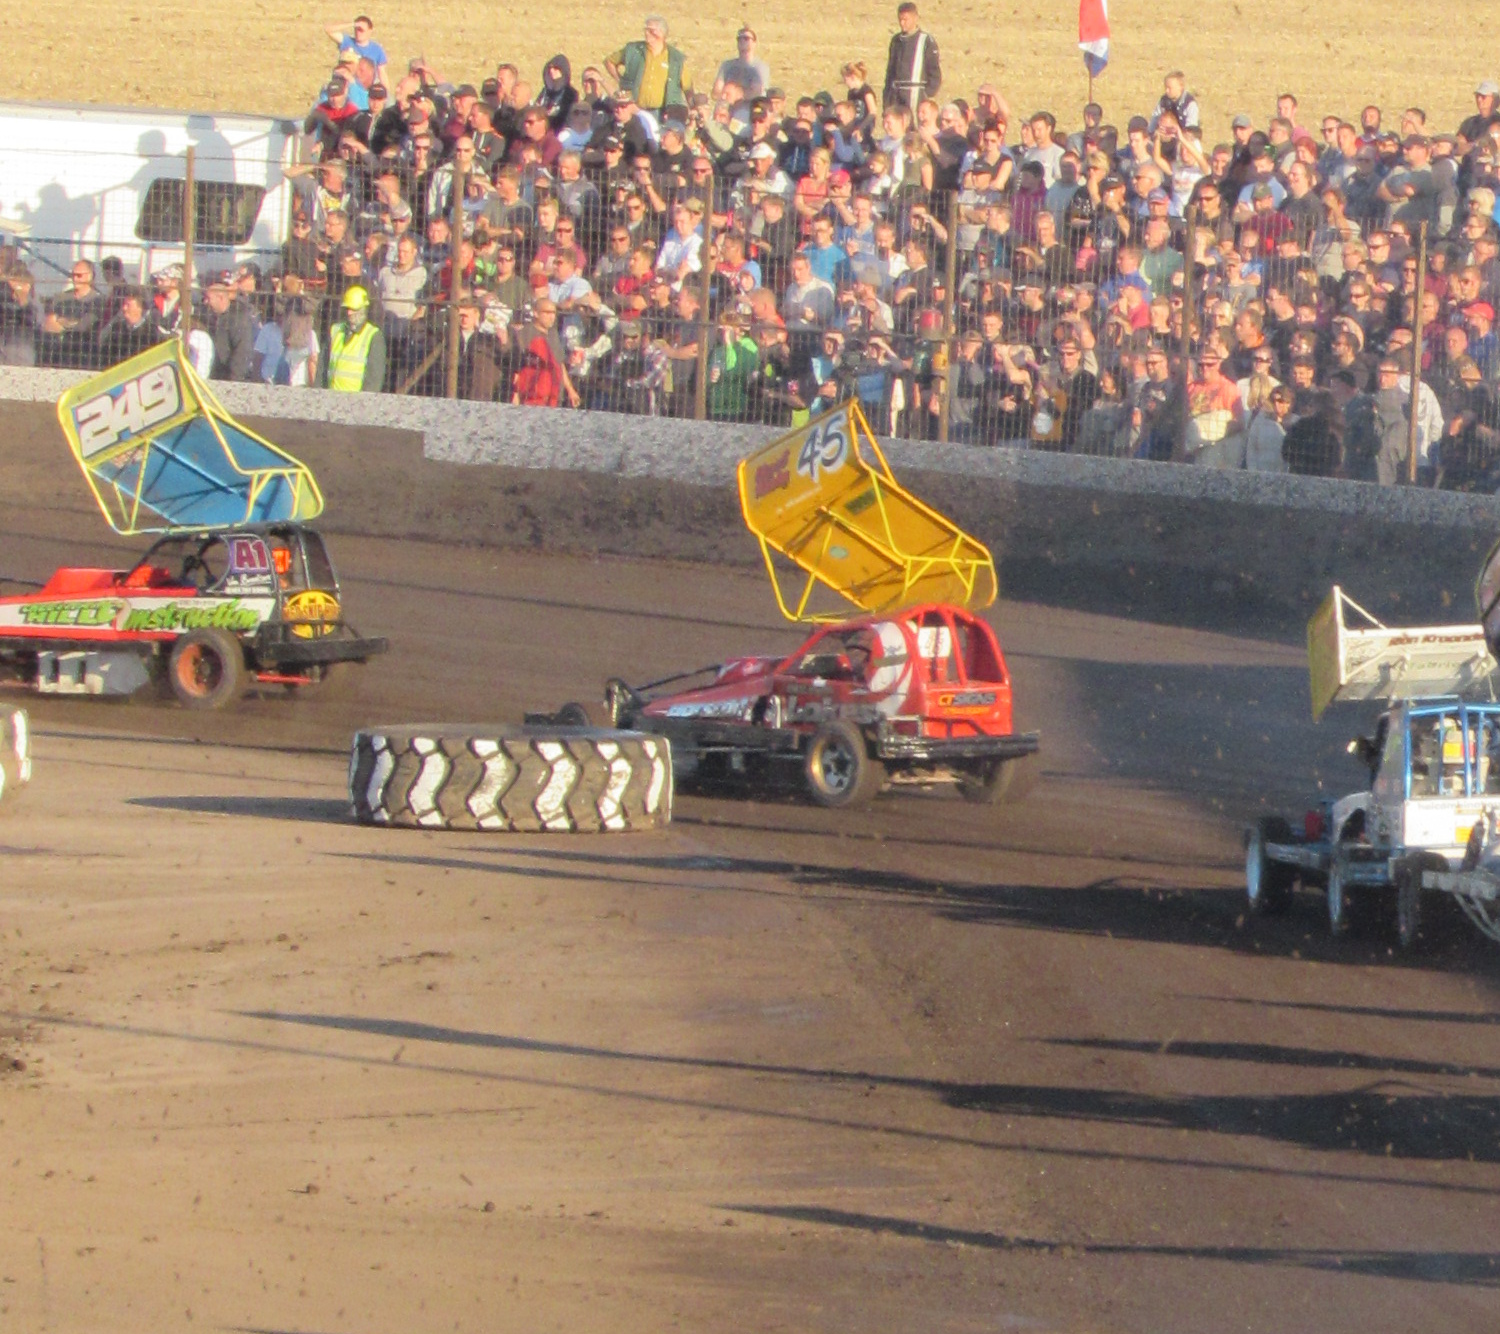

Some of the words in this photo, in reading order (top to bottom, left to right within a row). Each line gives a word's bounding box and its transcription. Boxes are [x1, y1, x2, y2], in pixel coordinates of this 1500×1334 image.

[76, 363, 181, 459] 249
[797, 411, 848, 482] 45
[235, 540, 269, 571] A1
